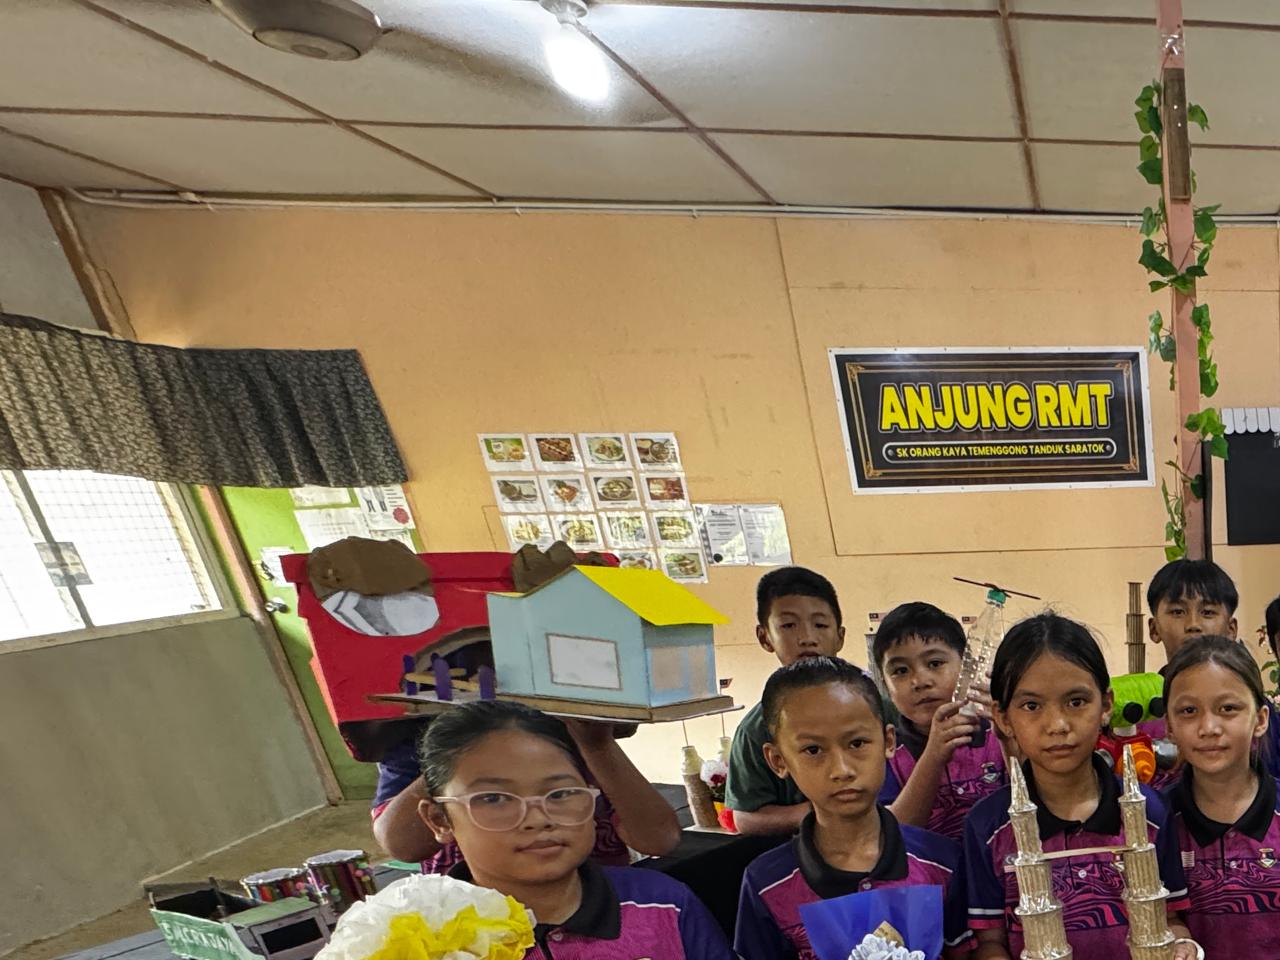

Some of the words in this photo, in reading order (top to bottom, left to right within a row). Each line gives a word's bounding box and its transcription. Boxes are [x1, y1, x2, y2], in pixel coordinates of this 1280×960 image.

[880, 382, 1033, 431] ANJUNG
[1034, 382, 1112, 429] RMT
[896, 447, 909, 458] SK
[910, 446, 942, 457] ORANG
[943, 446, 967, 457] KAYA
[968, 445, 1029, 456] TEMENGGONG
[1029, 444, 1064, 455] TANDUK
[1065, 443, 1105, 454] SARATOK
